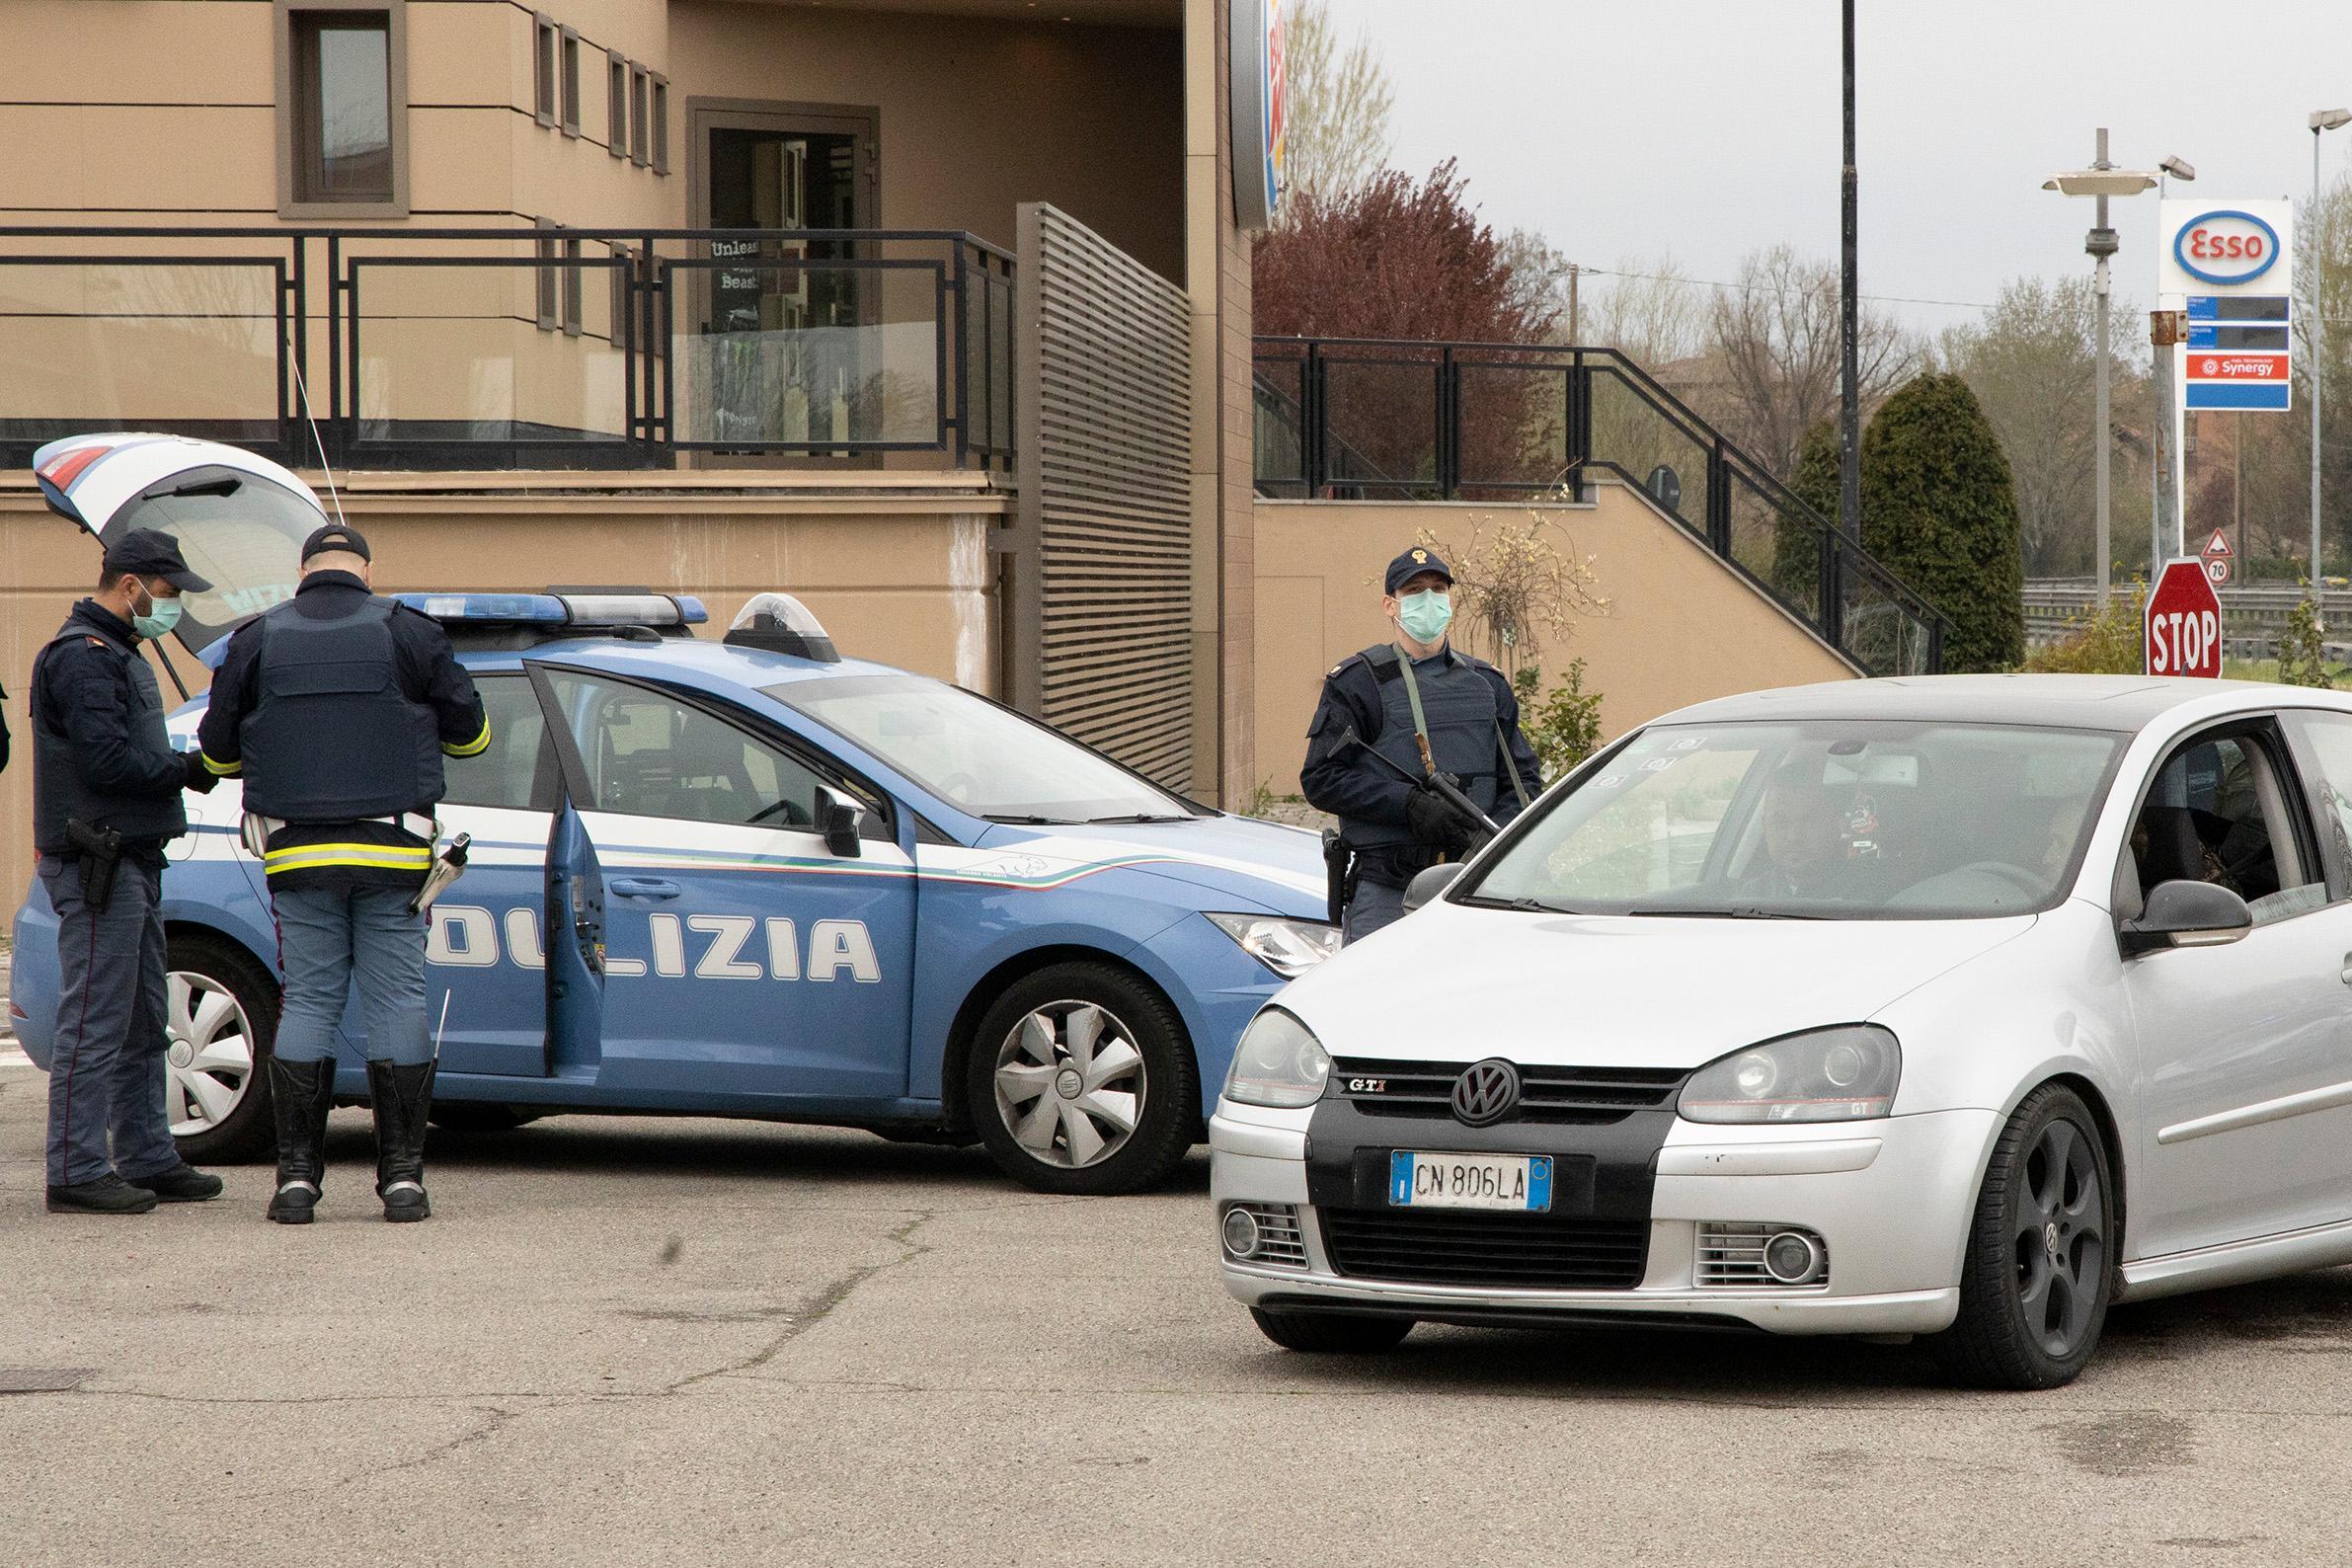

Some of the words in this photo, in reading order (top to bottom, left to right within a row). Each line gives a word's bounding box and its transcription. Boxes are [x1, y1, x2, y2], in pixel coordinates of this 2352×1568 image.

[2222, 360, 2273, 375] Synergy
[2212, 565, 2225, 578] 70
[2153, 610, 2217, 672] STOP
[1349, 1078, 1387, 1092] GTI
